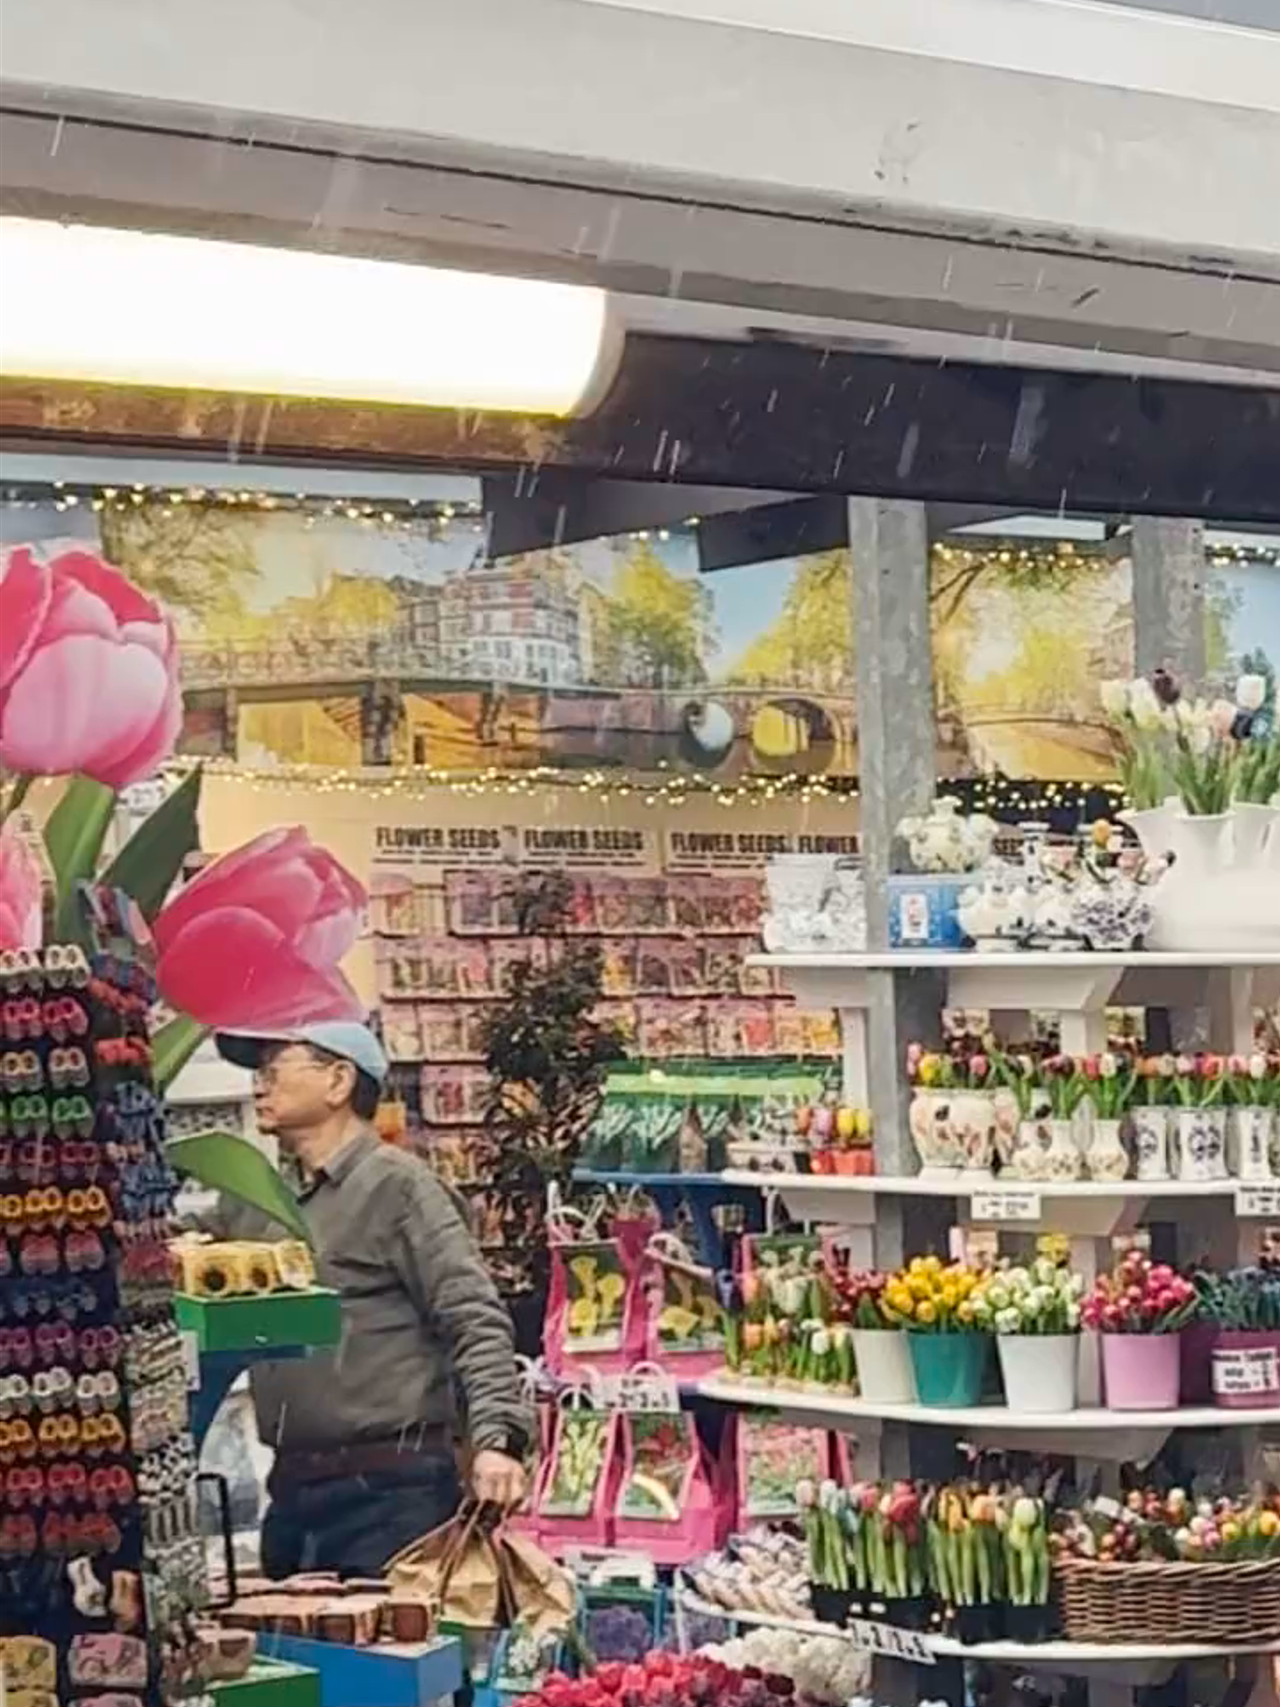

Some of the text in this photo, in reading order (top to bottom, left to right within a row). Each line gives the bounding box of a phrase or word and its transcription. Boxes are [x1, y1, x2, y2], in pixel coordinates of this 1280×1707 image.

[375, 826, 502, 850] FLOWER SEEDS
[523, 828, 644, 851] FLOWER SEEDS
[670, 831, 787, 855] FLOWER SEEDS
